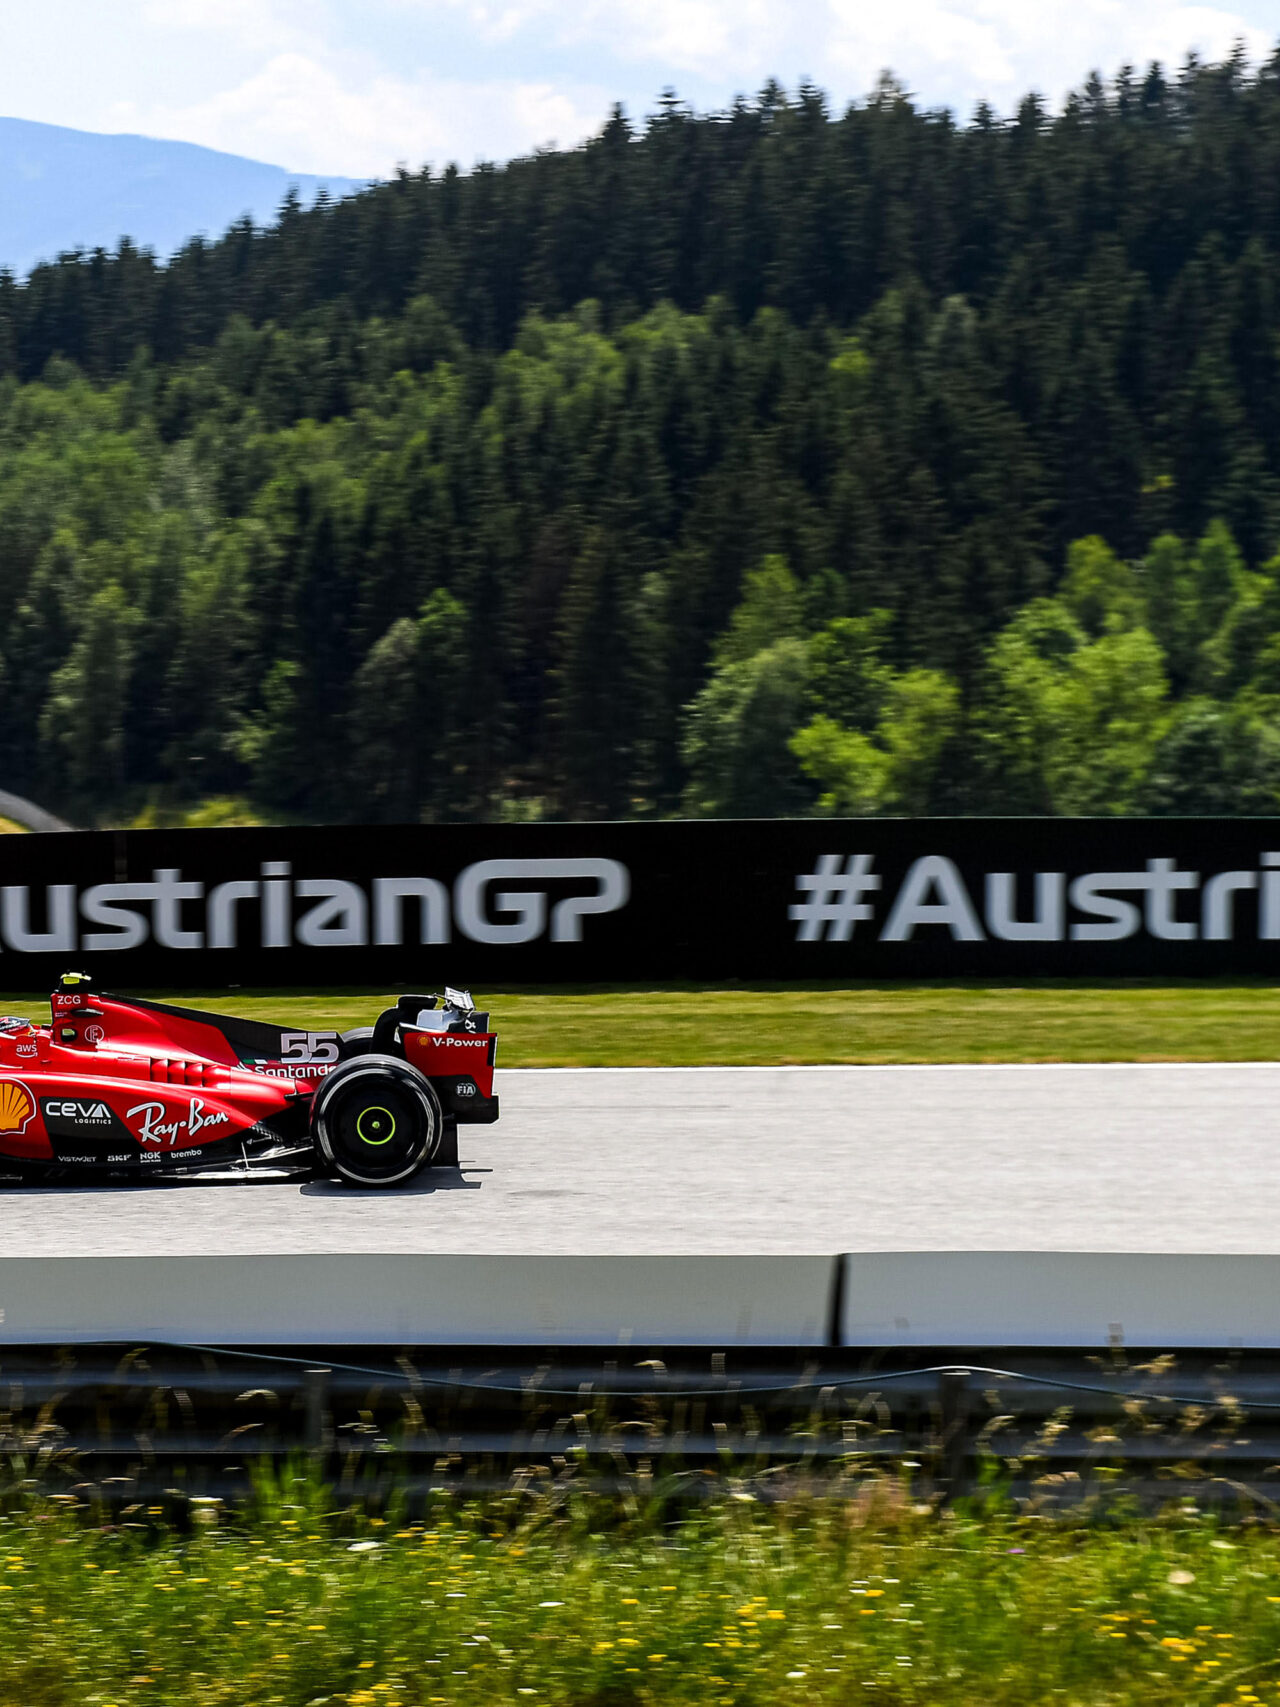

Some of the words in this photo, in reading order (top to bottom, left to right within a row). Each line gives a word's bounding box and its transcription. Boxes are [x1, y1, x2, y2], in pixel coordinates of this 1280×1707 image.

[57, 995, 81, 1005] ZCG
[432, 1037, 488, 1048] V-Power
[16, 1043, 37, 1053] aws
[280, 1032, 340, 1064] 55
[139, 1151, 161, 1160] NGK
[170, 1149, 202, 1159] brembo
